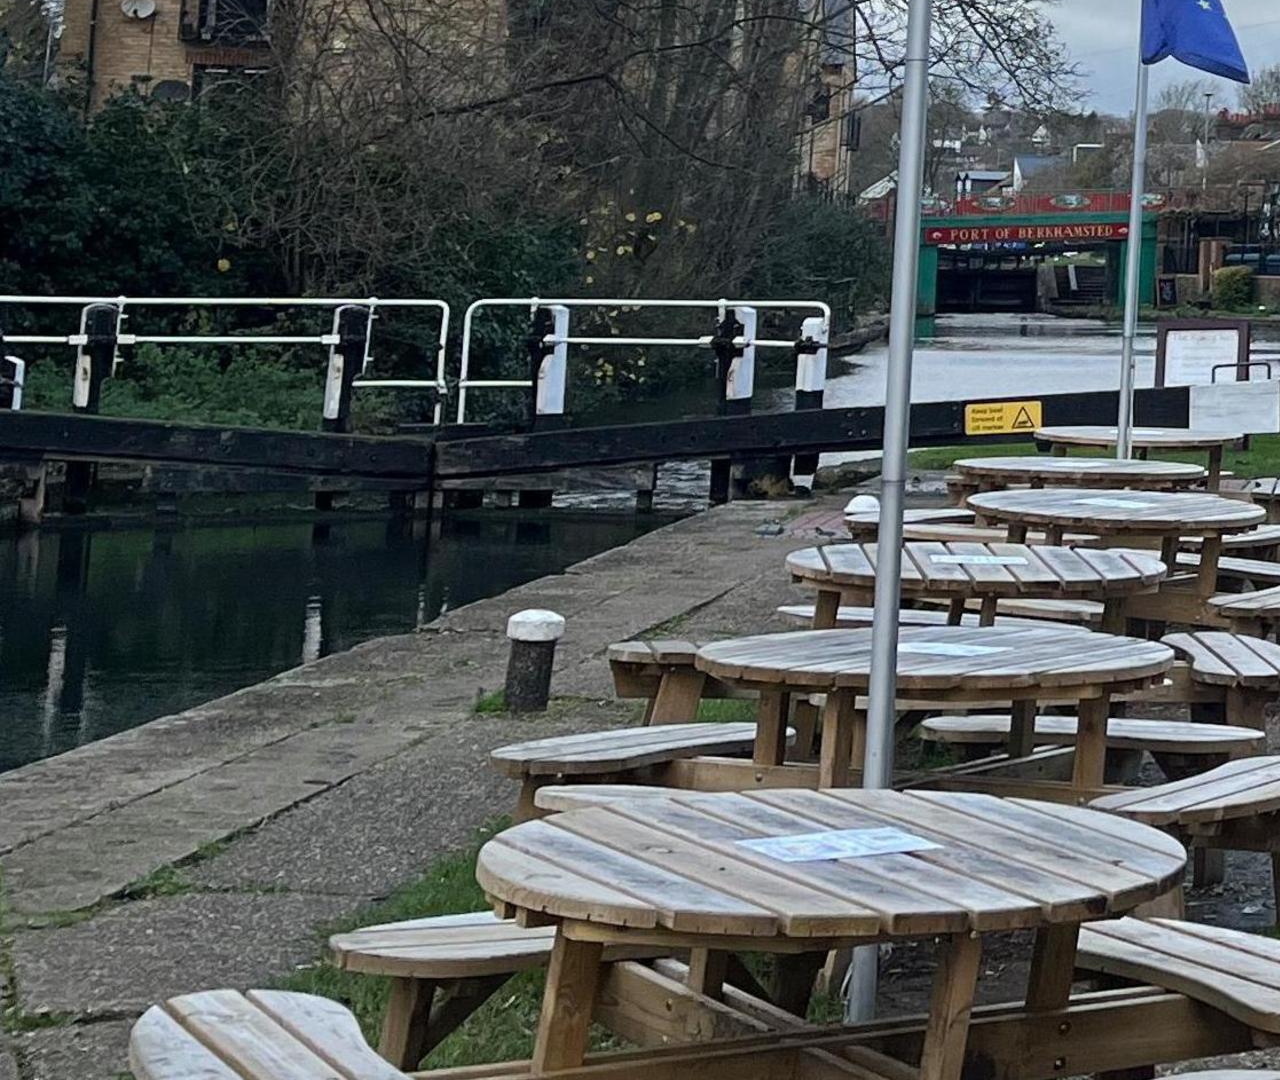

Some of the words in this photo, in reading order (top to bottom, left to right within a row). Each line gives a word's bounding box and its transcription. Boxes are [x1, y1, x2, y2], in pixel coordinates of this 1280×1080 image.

[950, 228, 988, 242] PORT
[995, 227, 1009, 240] OF
[1018, 223, 1114, 240] BERKHAMSTED
